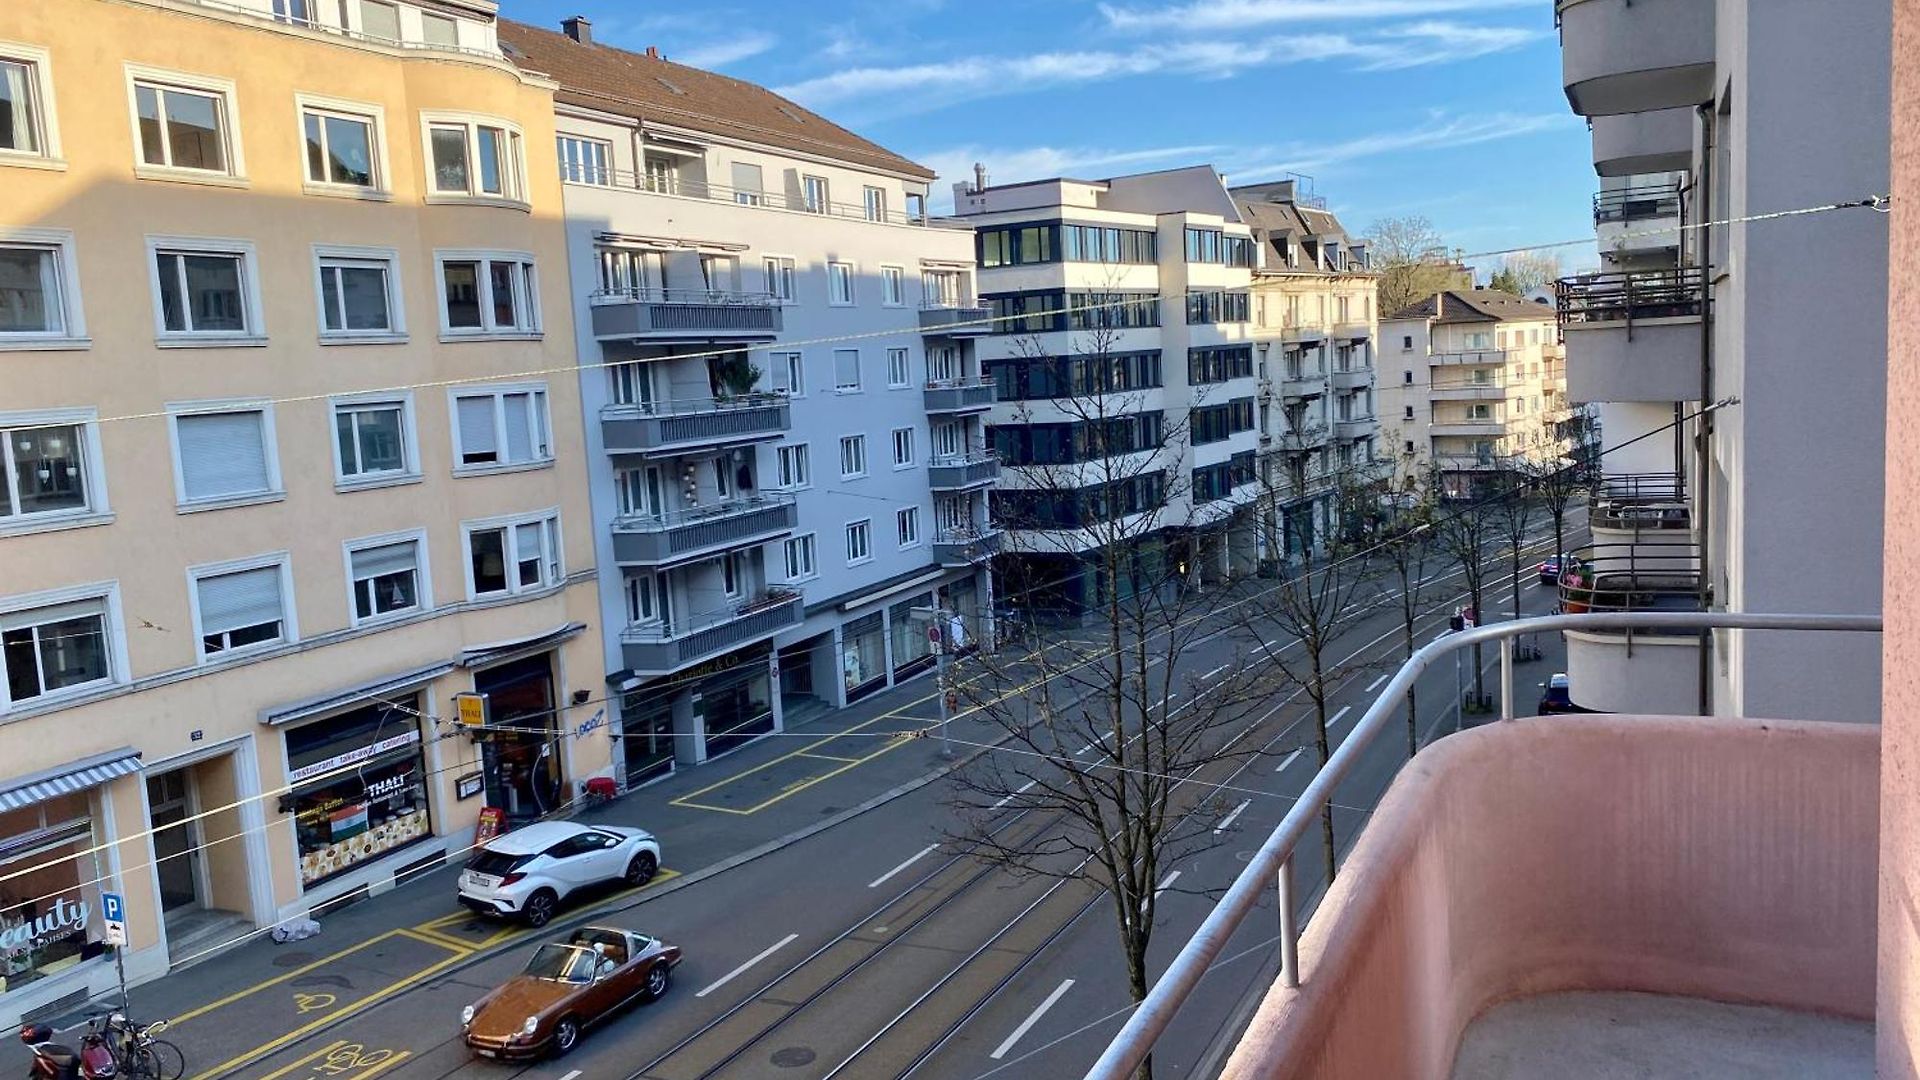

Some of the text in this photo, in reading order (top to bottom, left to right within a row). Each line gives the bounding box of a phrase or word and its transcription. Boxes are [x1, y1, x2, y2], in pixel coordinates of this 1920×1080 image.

[293, 735, 411, 779] restaurant take-away catering
[368, 774, 404, 797] THALI
[107, 898, 118, 918] P
